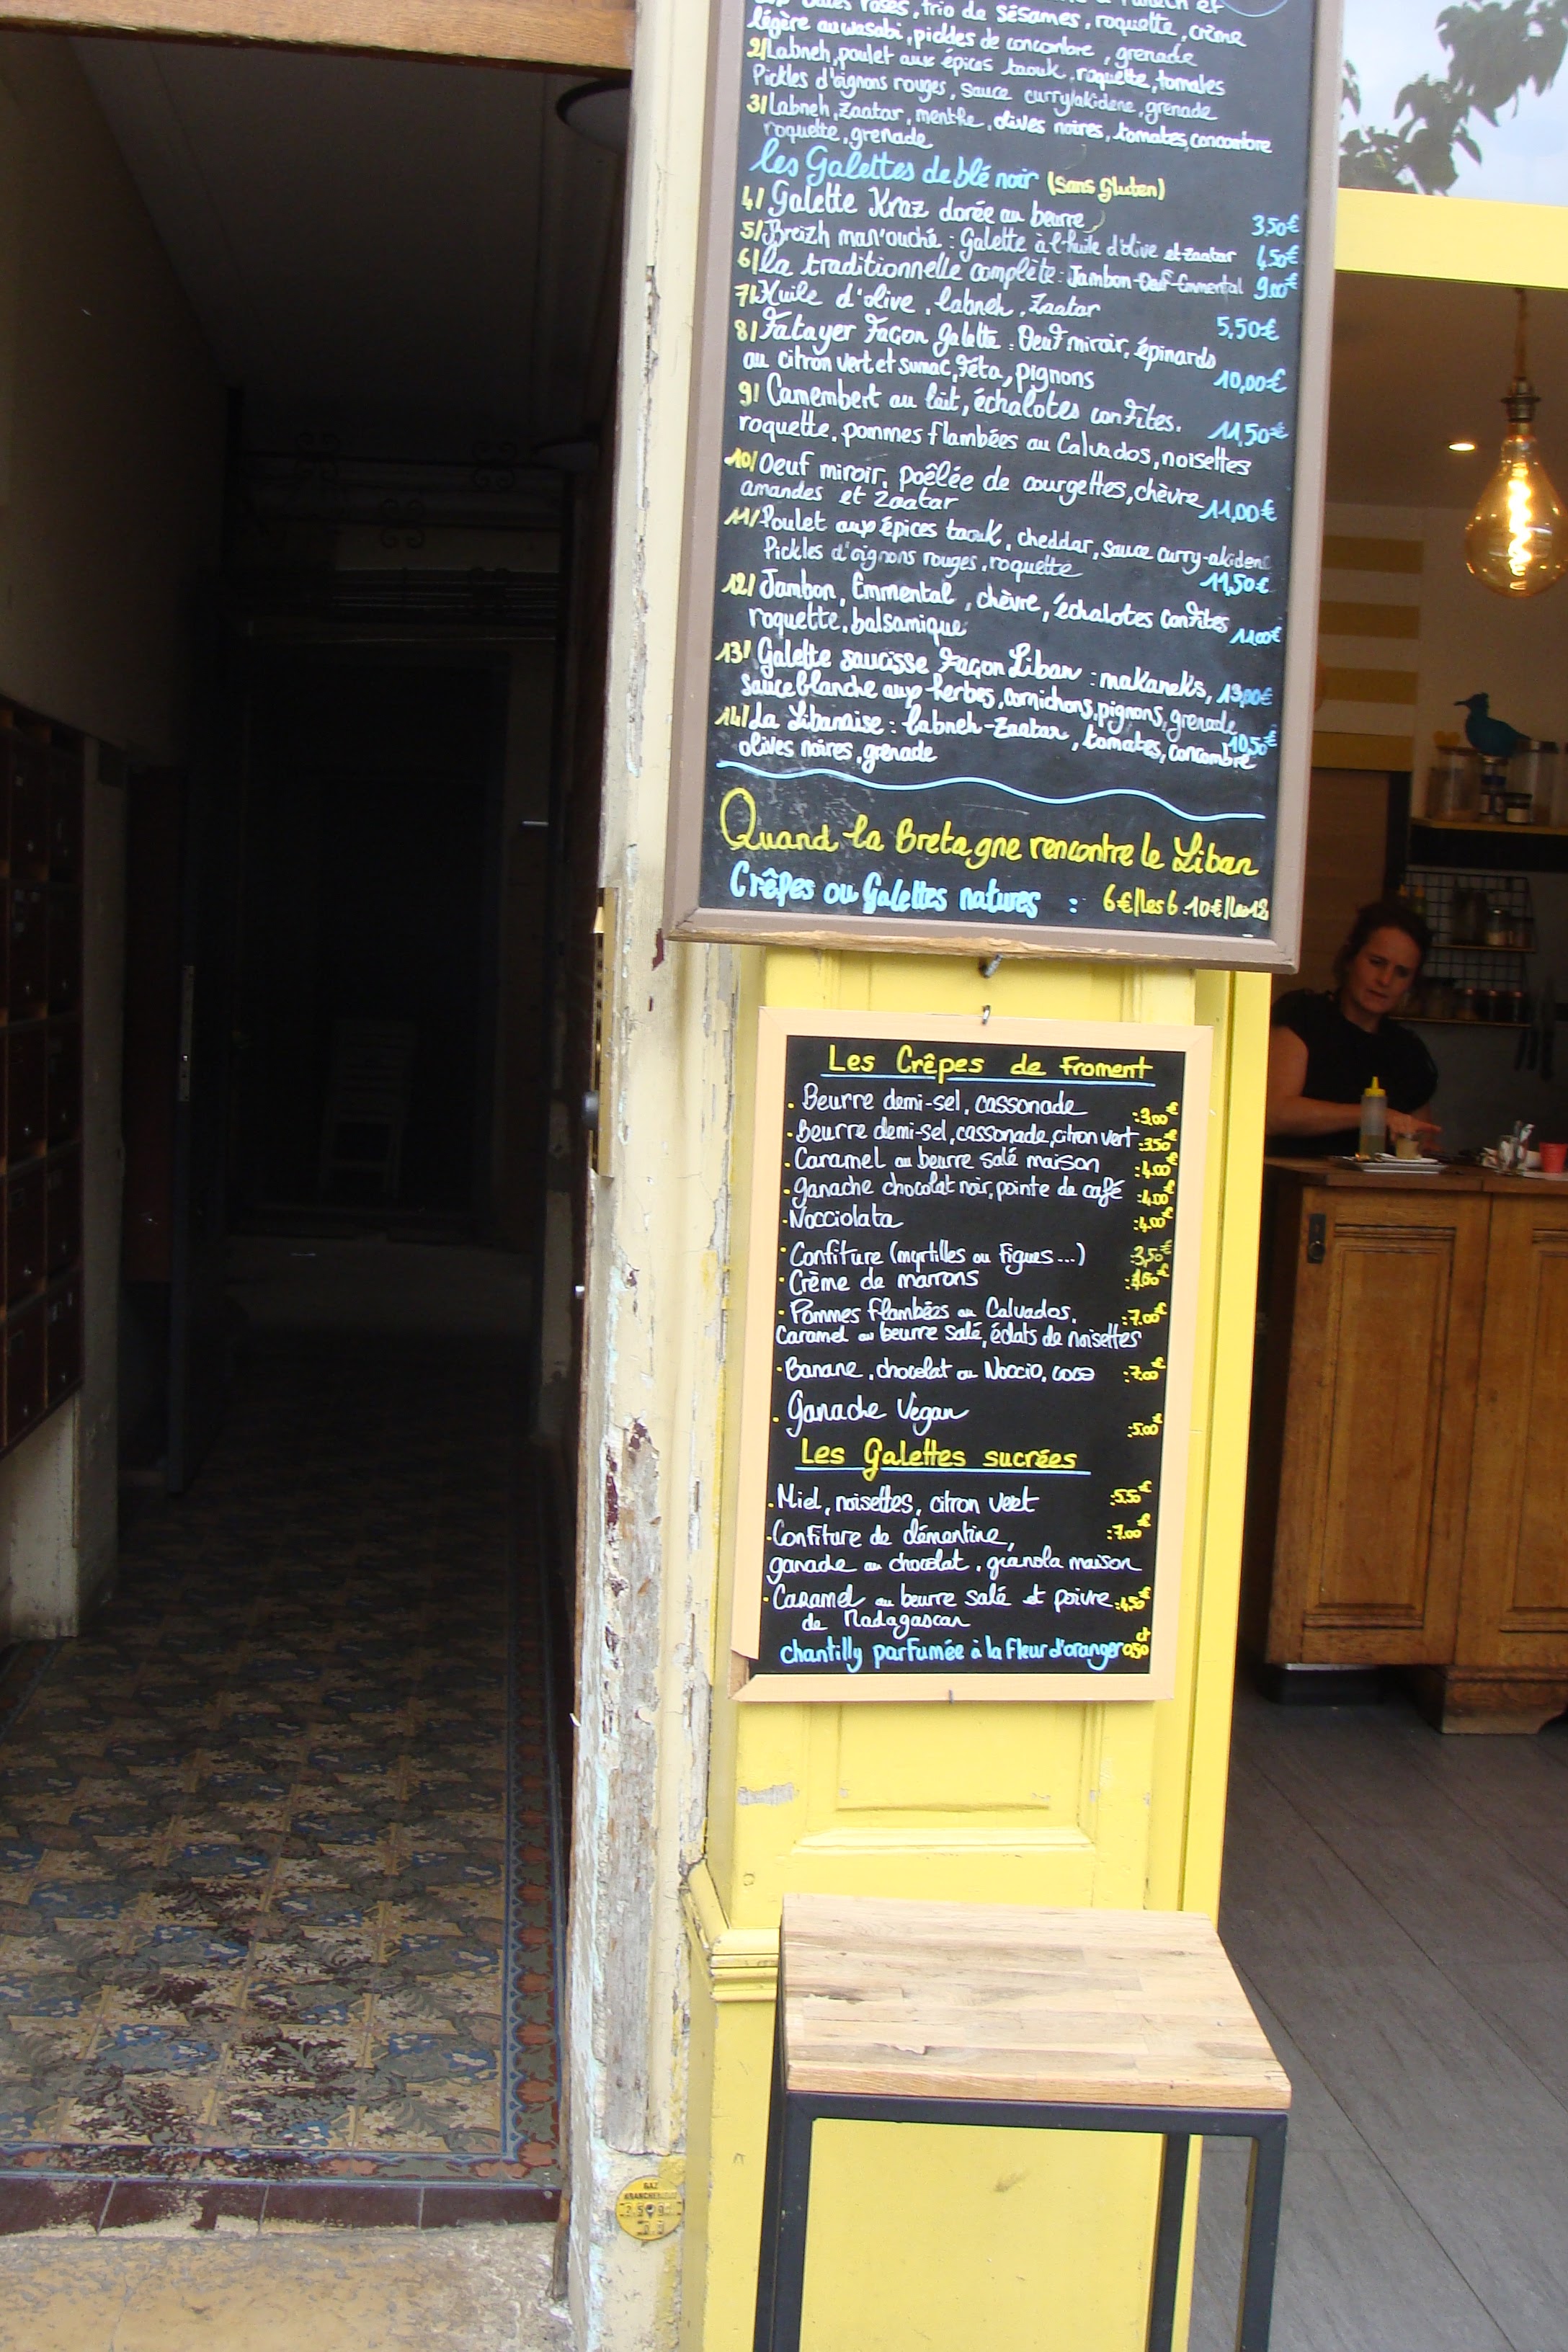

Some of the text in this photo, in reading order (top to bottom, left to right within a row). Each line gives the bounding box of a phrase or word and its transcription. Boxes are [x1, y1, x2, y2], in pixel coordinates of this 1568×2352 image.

[941, 48, 993, 76] épices
[922, 155, 951, 184] de
[953, 157, 991, 189] blé
[995, 169, 1039, 191] noir
[868, 186, 929, 219] Kraz
[939, 196, 995, 223] dorée
[1030, 200, 1084, 229] beurre
[800, 251, 963, 282] traditionnelle
[1134, 336, 1216, 371] épinards
[742, 351, 769, 370] au
[778, 348, 832, 371] citron
[876, 348, 896, 374] et
[1015, 362, 1094, 393] pignons
[766, 372, 882, 410] Camembert
[889, 392, 917, 409] au
[974, 383, 1079, 420] échalotes
[928, 420, 1017, 451] flambées
[1026, 438, 1050, 452] au
[740, 479, 866, 507] amandes et
[899, 460, 973, 494] poêlée
[983, 465, 1009, 492] de
[879, 516, 937, 546] épices
[840, 651, 929, 676] saucisse
[739, 733, 937, 775] olives noires grenade
[721, 787, 838, 852] Quand
[895, 817, 1022, 870] Bretagne
[1030, 832, 1133, 866] rencontre
[1141, 832, 1165, 870] le
[1172, 832, 1259, 876] Liban
[730, 860, 816, 907] Crêpes
[824, 881, 858, 905] ou
[959, 878, 1041, 919] natures
[829, 1044, 876, 1072] Les
[896, 1044, 985, 1084] Crêpes
[1010, 1053, 1046, 1076] de
[802, 1082, 1088, 1115] Beurre cassonade
[796, 1118, 1139, 1148] Beurre vert
[794, 1145, 1100, 1173] Caramel au beurre salé maison
[883, 1171, 956, 1197] chocolat
[1057, 1175, 1077, 1196] de
[1082, 1177, 1125, 1208] café
[789, 1203, 904, 1229] Nocciolata
[790, 1239, 884, 1267] Confiture
[788, 1266, 979, 1296] Crème de marrons
[790, 1296, 976, 1324] Pommes flambées au
[775, 1322, 1142, 1350] Caramel au beurre de noisettes
[785, 1355, 863, 1381] Banane
[896, 1391, 969, 1436] Vegan
[801, 1437, 845, 1464] Les
[982, 1448, 1077, 1469] sucrées
[777, 1482, 822, 1510] Miel
[930, 1489, 980, 1515] citron
[772, 1518, 893, 1548] Confiture de
[864, 1562, 882, 1572] au
[888, 1549, 969, 1572] chocolat
[986, 1545, 1064, 1580] granola
[1069, 1554, 1142, 1572] maison
[874, 1597, 894, 1608] au
[900, 1583, 957, 1608] beurre
[964, 1583, 1011, 1606] salé
[1023, 1584, 1046, 1605] et
[1054, 1587, 1113, 1613] poivre
[801, 1608, 971, 1639] de Madagascar
[780, 1636, 863, 1673] chantilly
[872, 1638, 965, 1670] parfumée
[971, 1639, 982, 1660] à
[984, 1634, 1002, 1660] la
